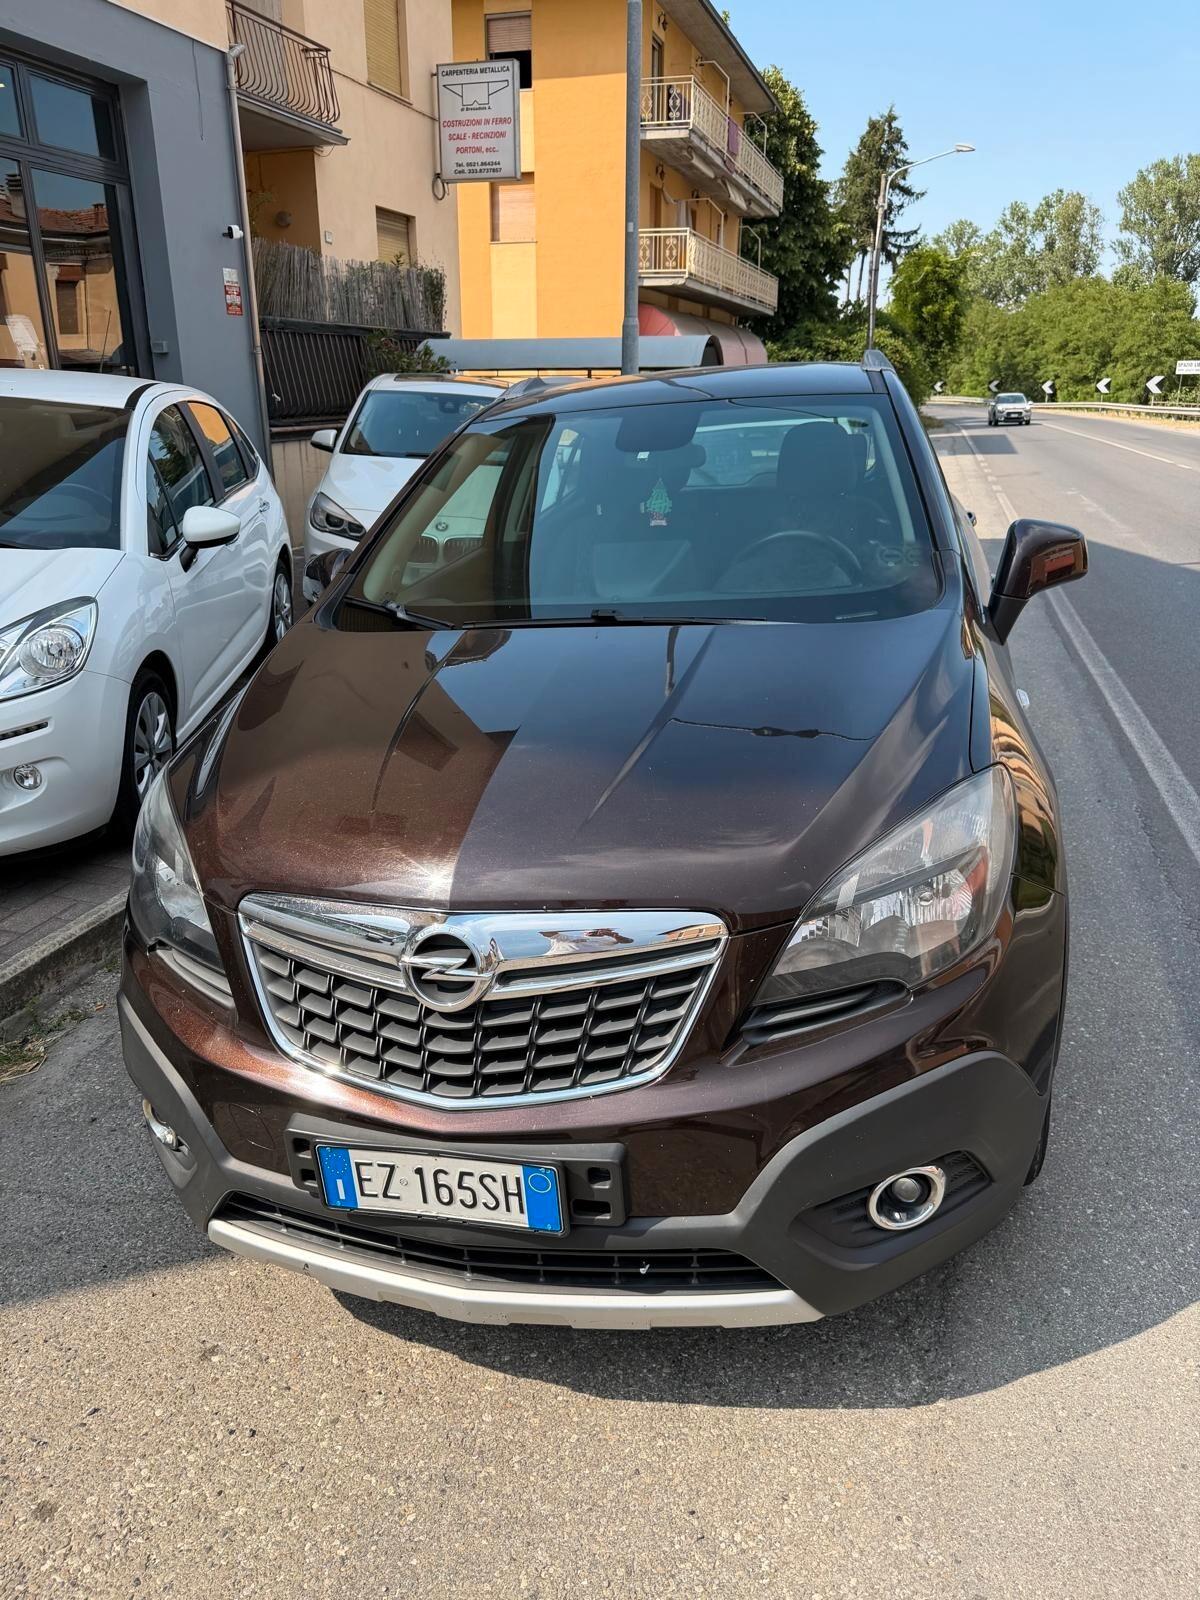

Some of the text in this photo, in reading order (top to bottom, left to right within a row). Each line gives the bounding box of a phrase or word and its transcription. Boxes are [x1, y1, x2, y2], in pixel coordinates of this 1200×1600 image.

[441, 65, 510, 77] CARPENTERIA METALLICA
[442, 116, 512, 128] COSTRUZIONI IN FERRO
[448, 132, 466, 141] SCALE
[471, 131, 507, 139] RECINZIONI
[455, 146, 485, 155] PORTONI,
[336, 1179, 346, 1200] I
[354, 1161, 526, 1215] EZ 165SH
